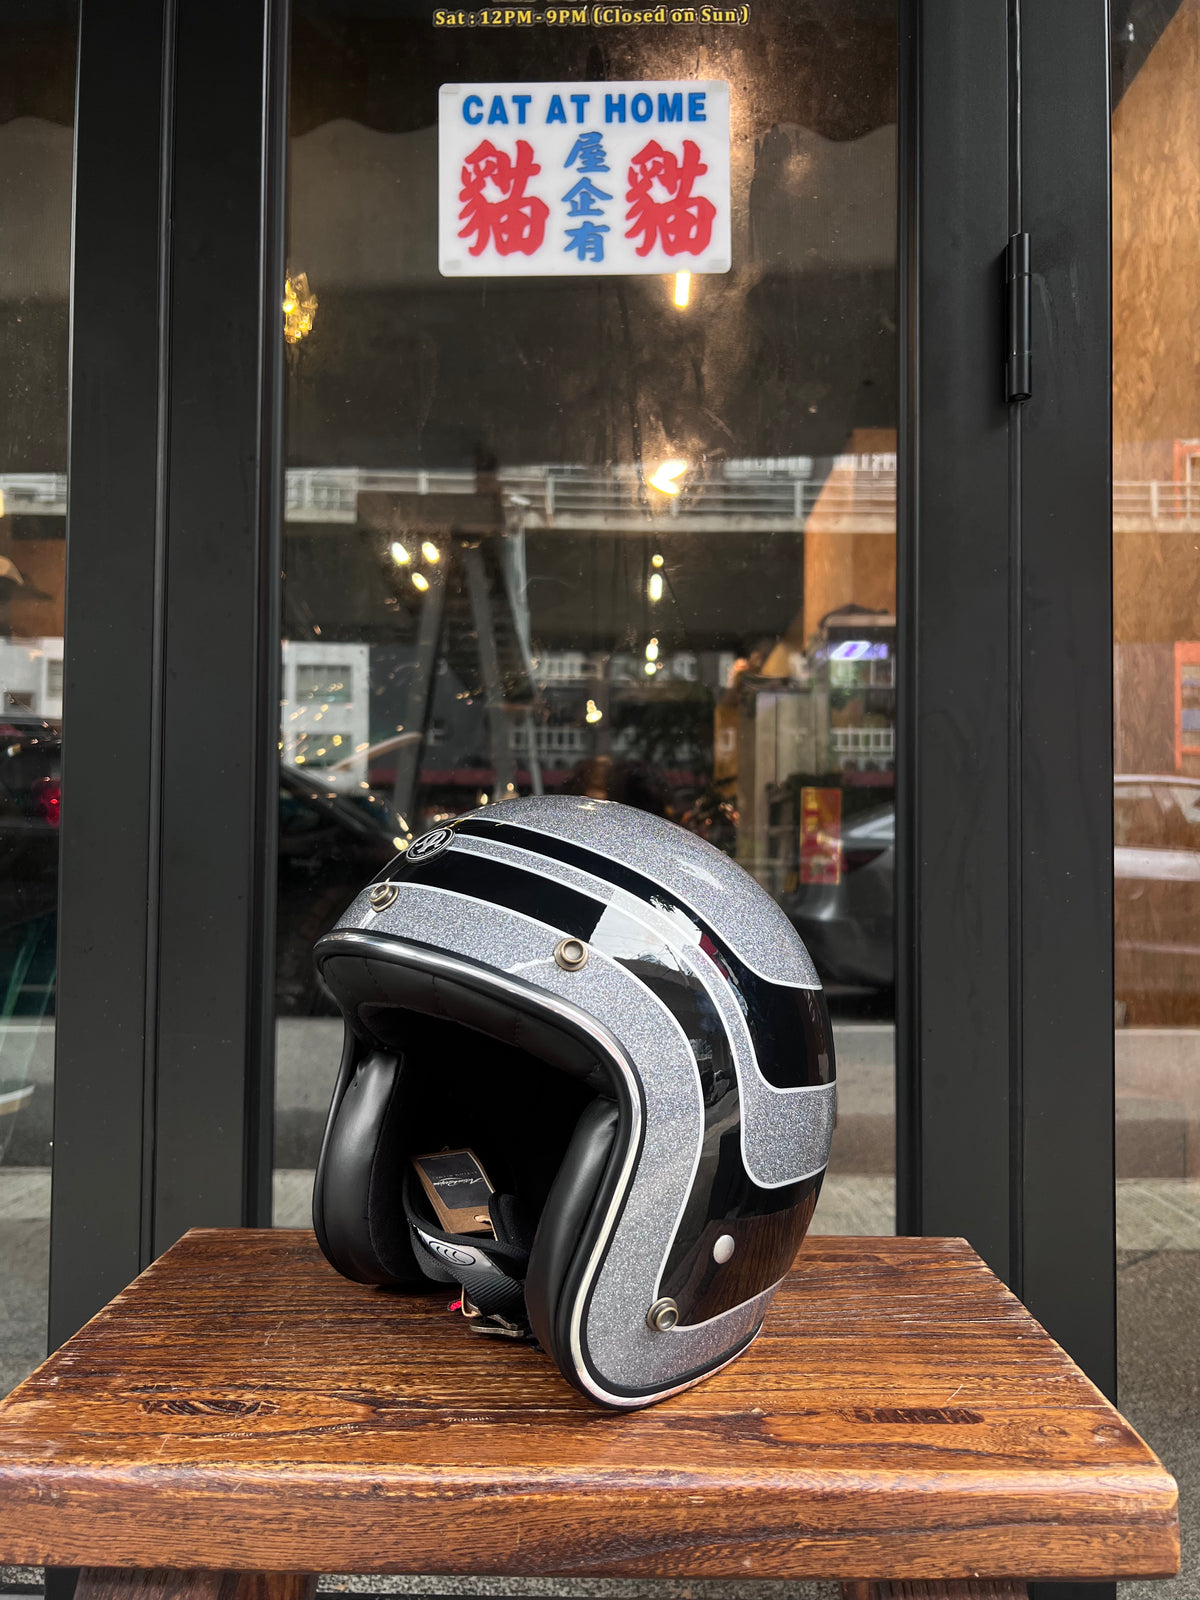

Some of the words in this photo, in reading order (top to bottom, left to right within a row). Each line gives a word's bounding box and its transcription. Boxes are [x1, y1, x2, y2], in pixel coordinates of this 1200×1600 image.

[593, 6, 666, 25] (Closed
[671, 11, 695, 23] on
[462, 95, 532, 125] CAT
[545, 94, 591, 125] AT
[604, 92, 707, 124] HOME
[457, 138, 550, 257] 貓
[560, 131, 613, 263] 屋企有
[624, 138, 717, 257] 貓
